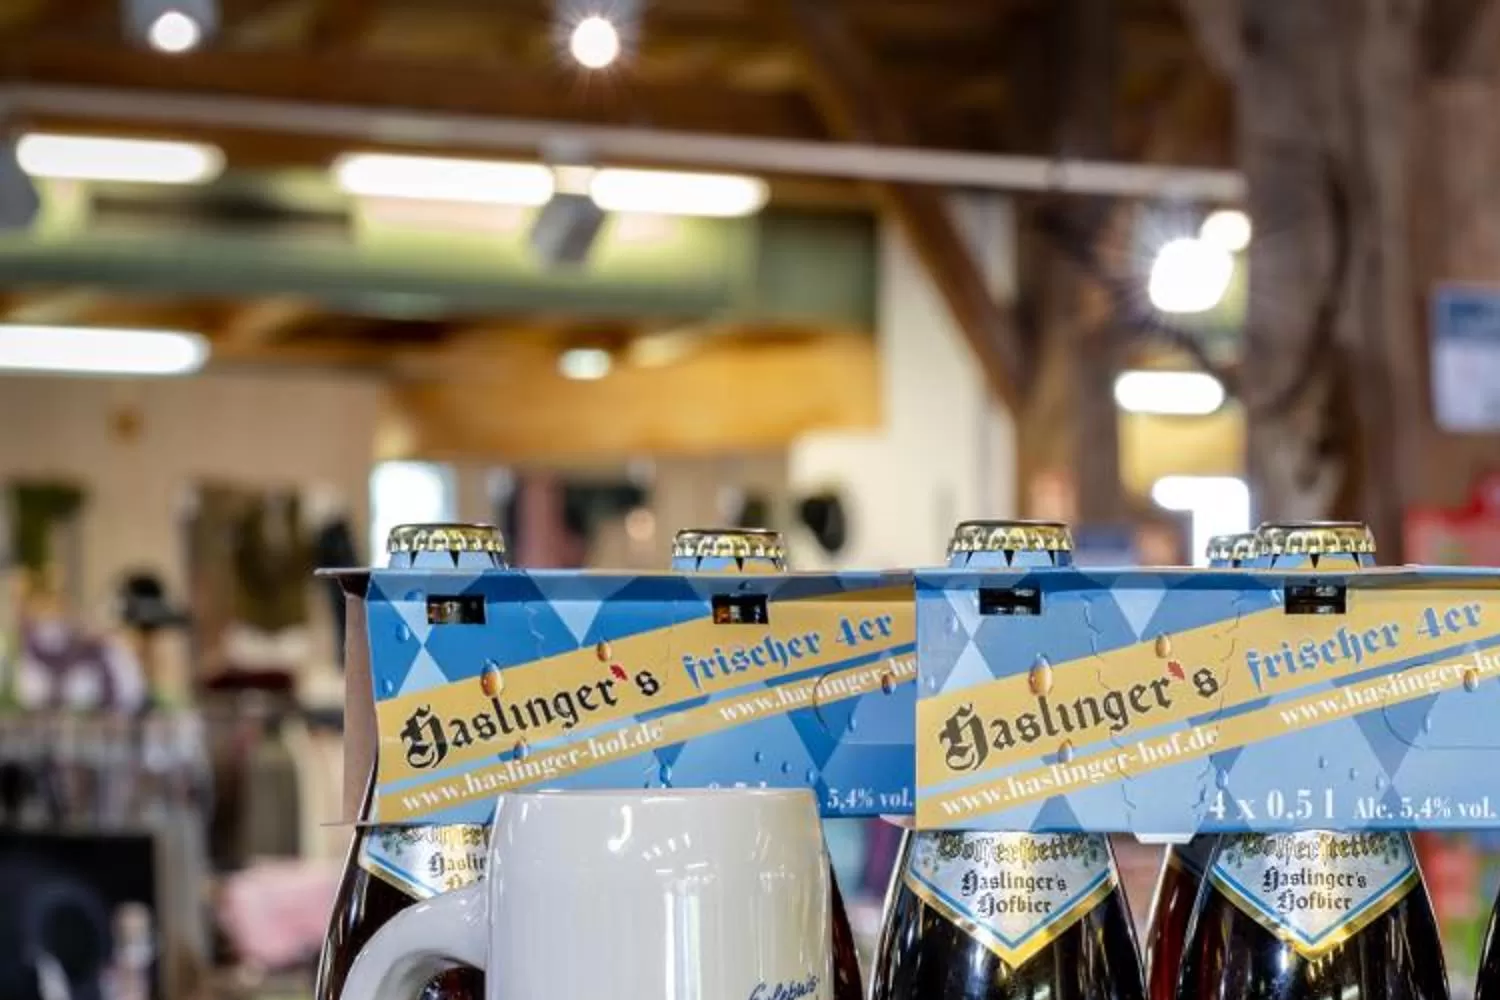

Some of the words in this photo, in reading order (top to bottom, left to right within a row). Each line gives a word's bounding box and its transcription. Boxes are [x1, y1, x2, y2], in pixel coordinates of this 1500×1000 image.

[401, 664, 660, 769] Haslinger's
[682, 630, 822, 688] frischer
[835, 612, 894, 648] 4er
[938, 660, 1219, 770] Haslinger's
[1245, 620, 1399, 693] frischer
[1416, 600, 1482, 639] 4er
[402, 721, 665, 812] www.haslinger-hof.de
[941, 721, 1219, 817] www.haslinger-hof.de
[880, 788, 913, 808] vol.
[1208, 790, 1225, 820] 4
[1237, 799, 1256, 820] x
[1458, 797, 1497, 819] vol.
[977, 893, 1052, 918] Hofbier
[1277, 889, 1352, 915] Hofbier
